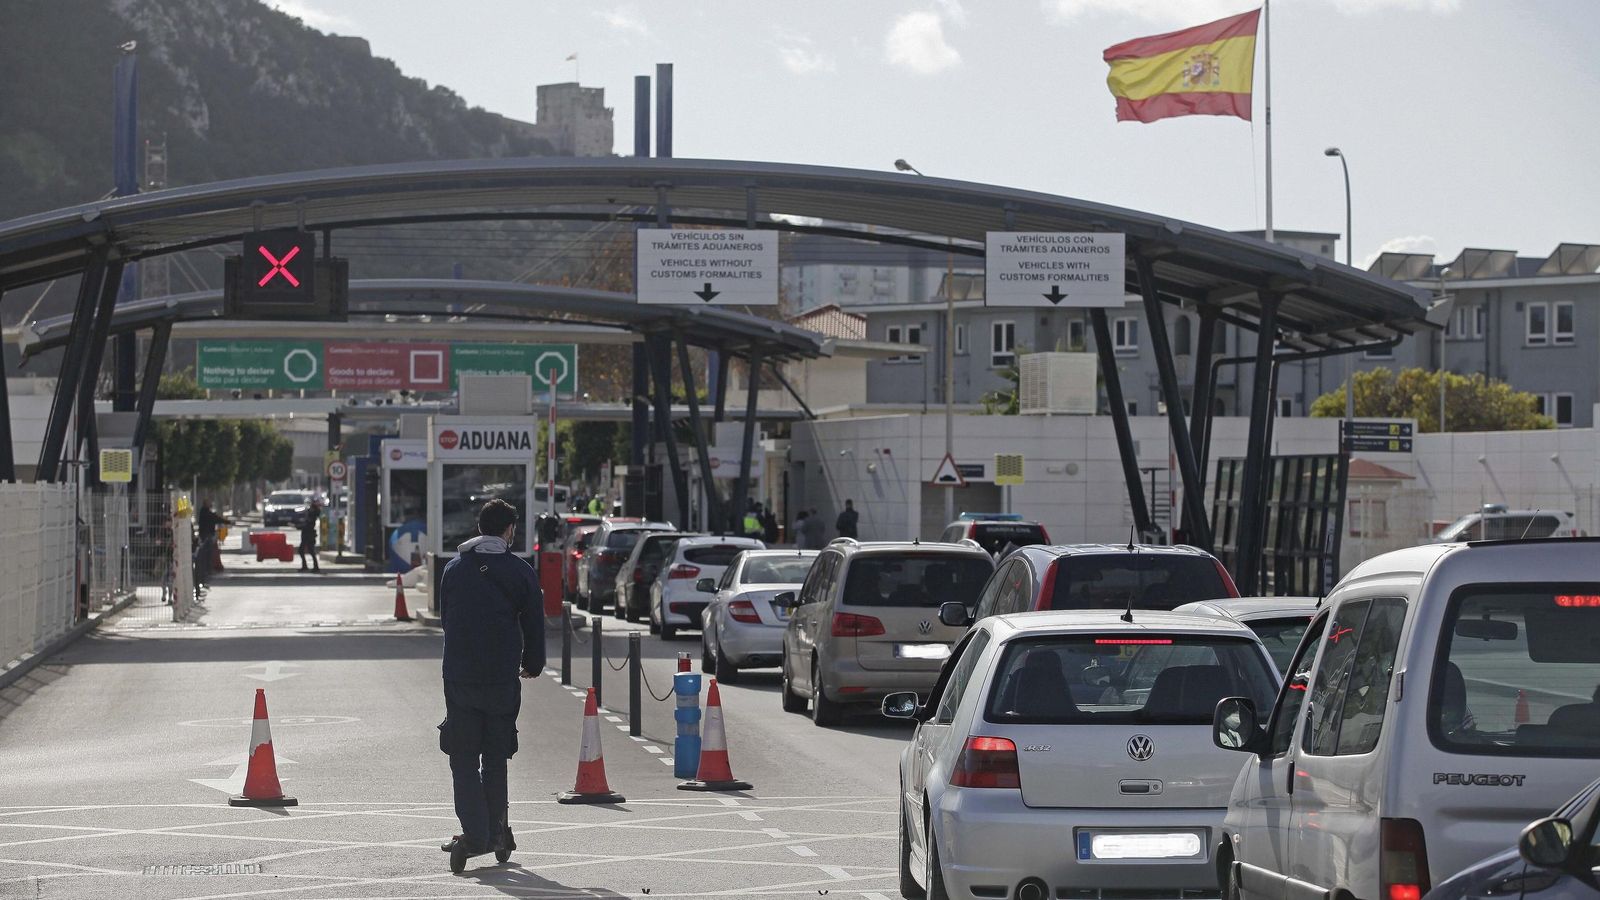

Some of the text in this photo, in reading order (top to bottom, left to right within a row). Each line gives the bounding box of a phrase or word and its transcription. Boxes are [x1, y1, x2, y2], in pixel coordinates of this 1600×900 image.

[670, 232, 745, 241] VEHÍCULOS SIN
[1016, 235, 1094, 244] VEHÍCULOS CON
[651, 241, 763, 251] TRÁMITES ADUANEROS
[1000, 244, 1110, 254] TRÁMITES ADUANEROS
[660, 259, 753, 268] VEHICLES WITHOUT
[1017, 261, 1090, 270] VEHICLES WITH
[650, 270, 763, 279] CUSTOMS FORMALITIES
[999, 272, 1110, 282] CUSTOMS FORMALITIES
[203, 367, 275, 376] Nothing to declare
[329, 367, 394, 376] Goods to declare
[203, 376, 268, 385] Nada para declarar
[459, 431, 531, 450] ADUANA
[332, 465, 343, 475] 10
[1433, 773, 1526, 787] PEUGEOT
